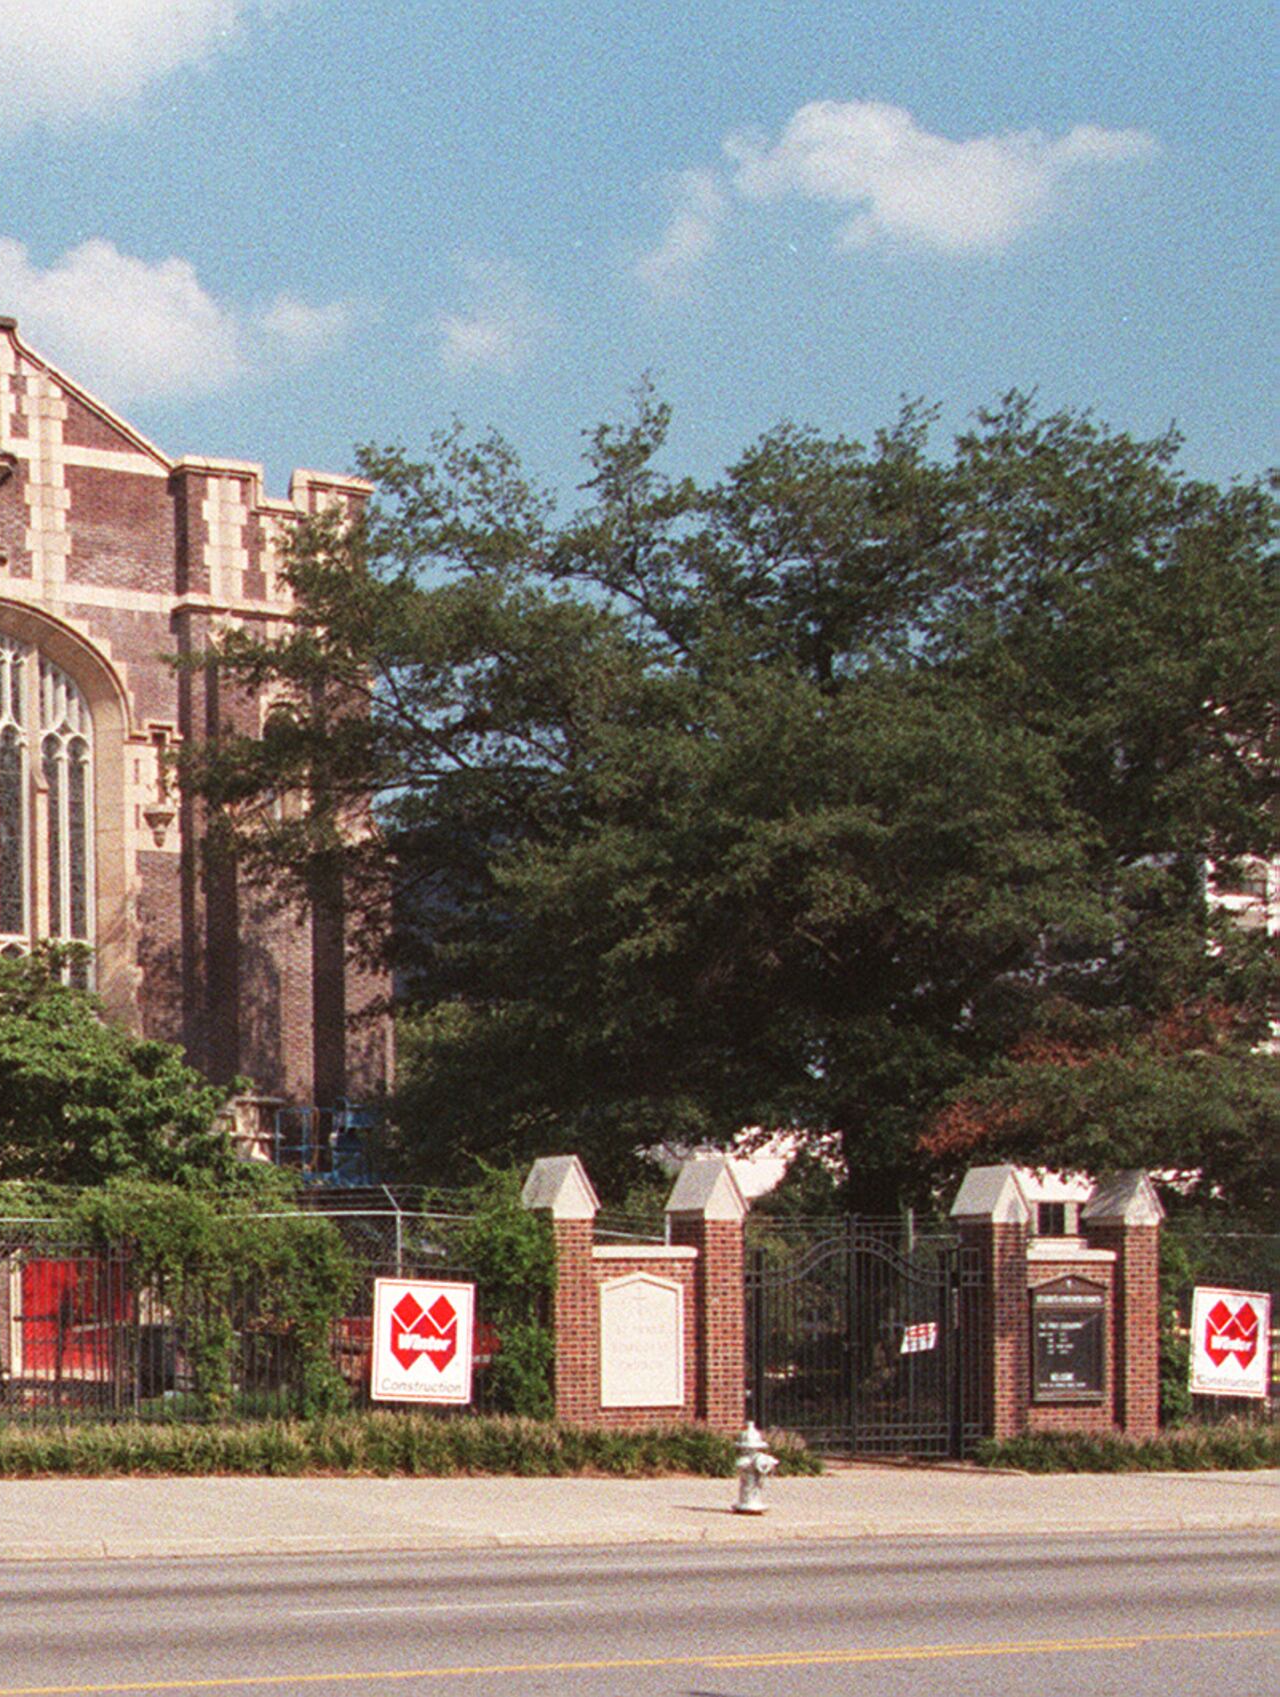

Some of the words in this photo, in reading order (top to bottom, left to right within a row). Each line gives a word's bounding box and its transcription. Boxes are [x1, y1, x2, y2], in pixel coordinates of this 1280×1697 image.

[397, 1332, 452, 1351] Winter
[1210, 1334, 1254, 1352] Winter
[380, 1377, 462, 1393] Construction
